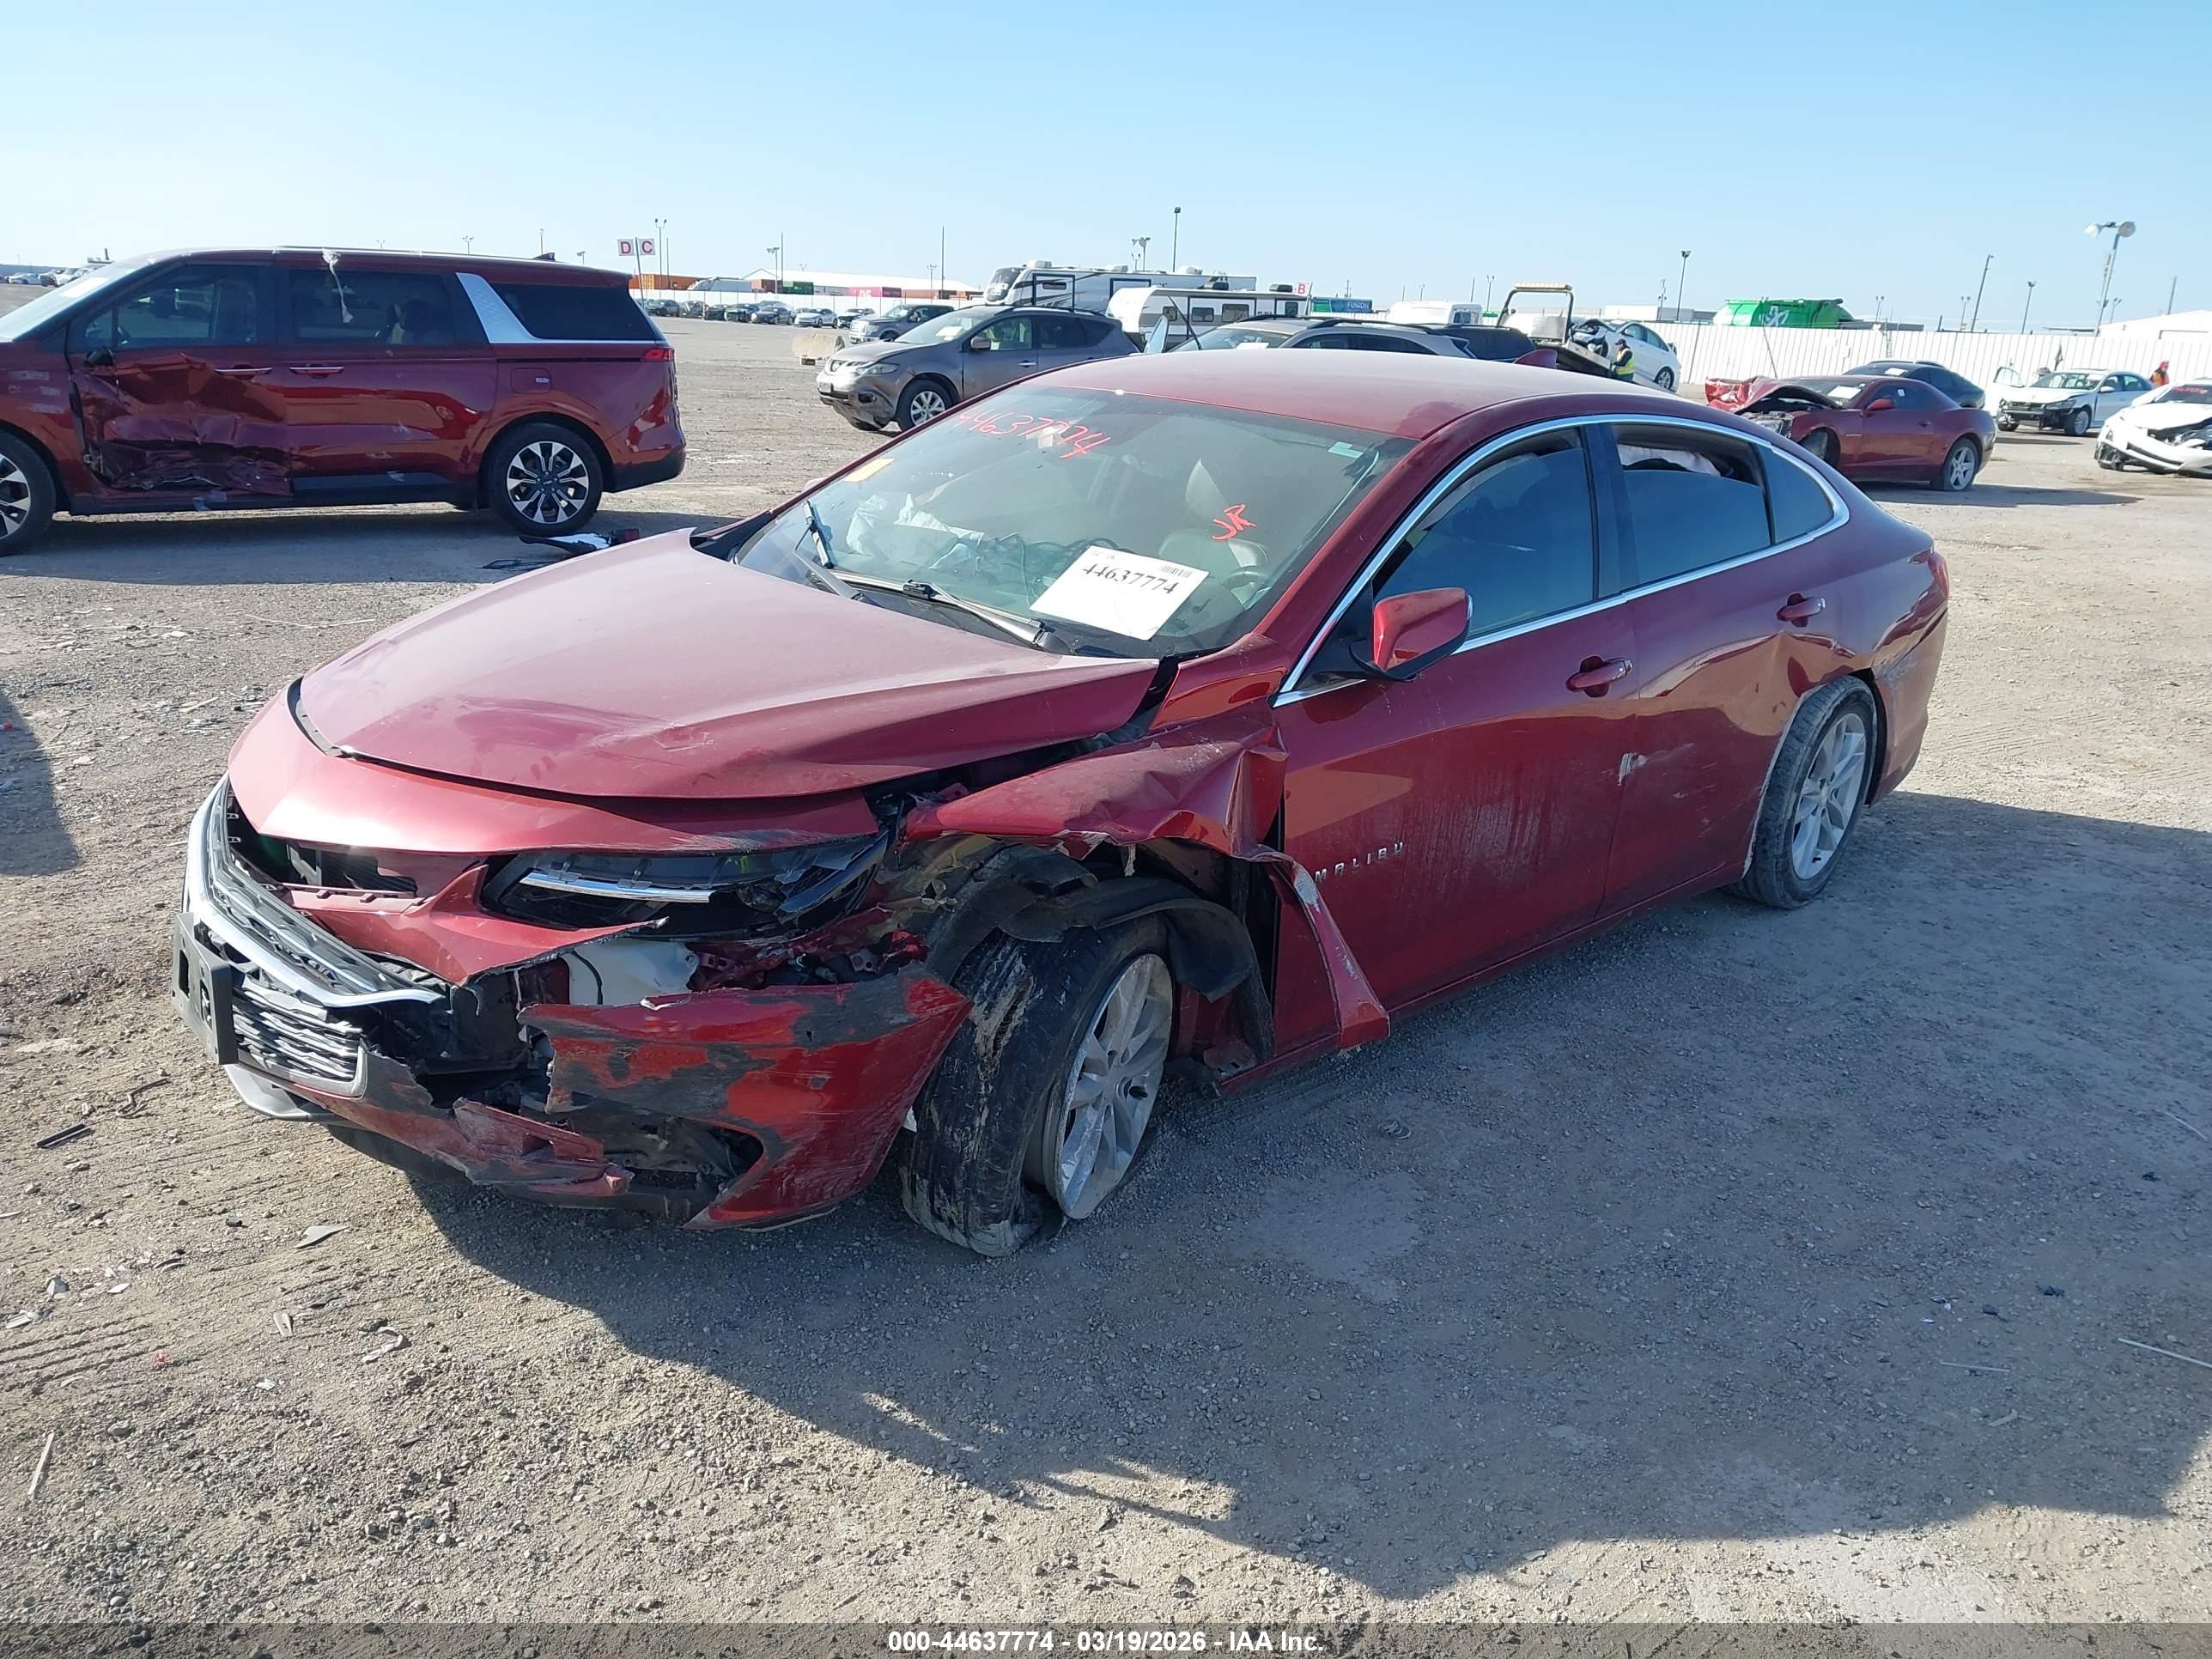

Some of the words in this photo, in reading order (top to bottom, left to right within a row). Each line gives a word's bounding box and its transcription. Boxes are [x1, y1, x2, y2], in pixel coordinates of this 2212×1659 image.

[620, 241, 631, 254] D
[641, 240, 653, 253] C
[1297, 283, 1305, 294] B
[952, 409, 1112, 459] 44637774
[1082, 562, 1179, 594] 44637774
[1315, 842, 1404, 882] MALIBU
